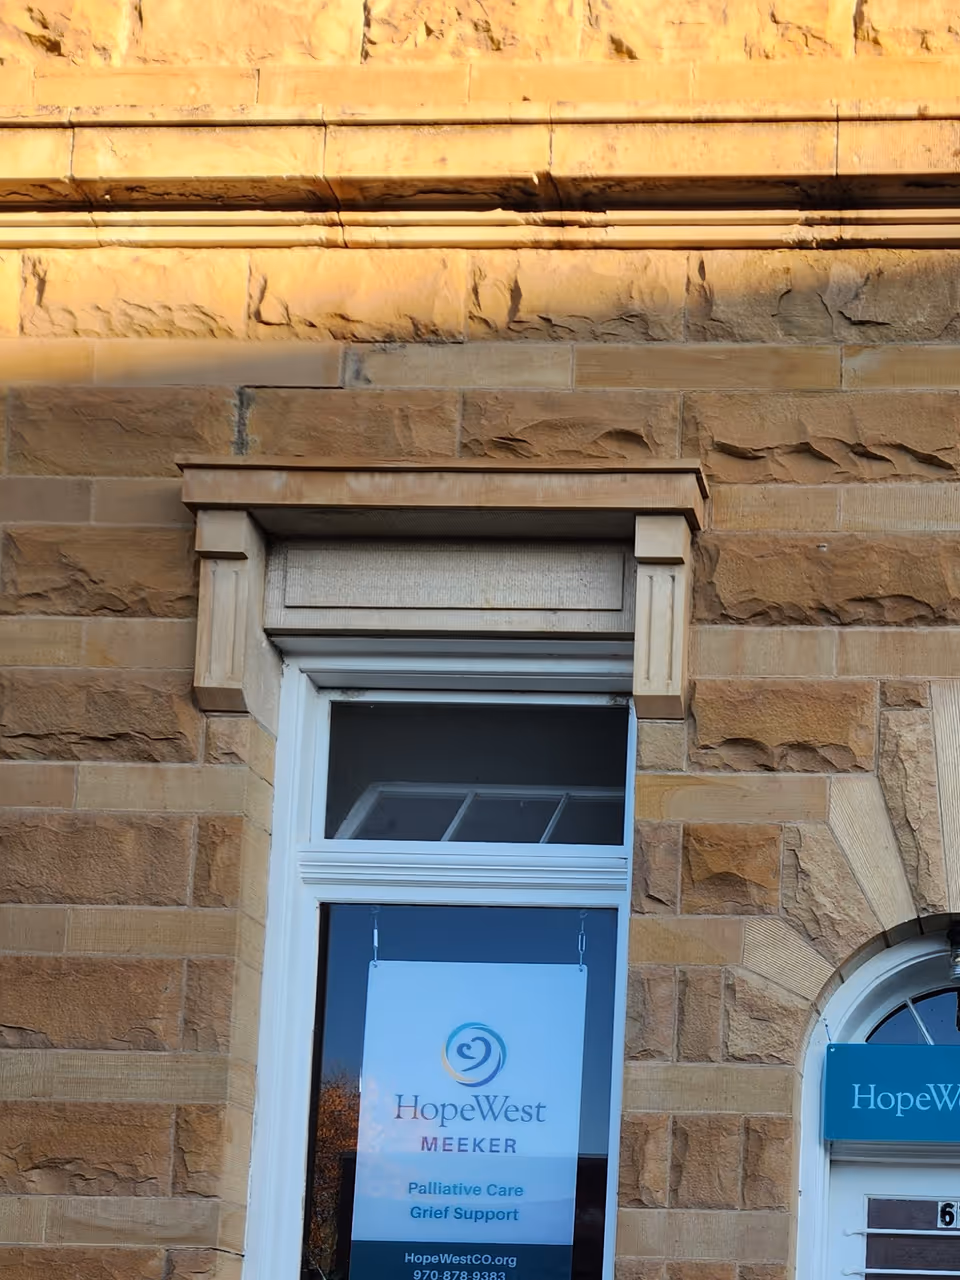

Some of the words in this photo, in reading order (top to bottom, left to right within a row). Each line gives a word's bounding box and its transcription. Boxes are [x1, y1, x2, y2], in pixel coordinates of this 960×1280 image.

[394, 1094, 547, 1128] HopeWest
[420, 1136, 518, 1154] MEEKER
[408, 1182, 482, 1196] Palliative
[486, 1184, 524, 1197] Care
[410, 1206, 450, 1219] Grief
[453, 1207, 519, 1223] Support
[404, 1252, 518, 1268] HopeWestCO.org
